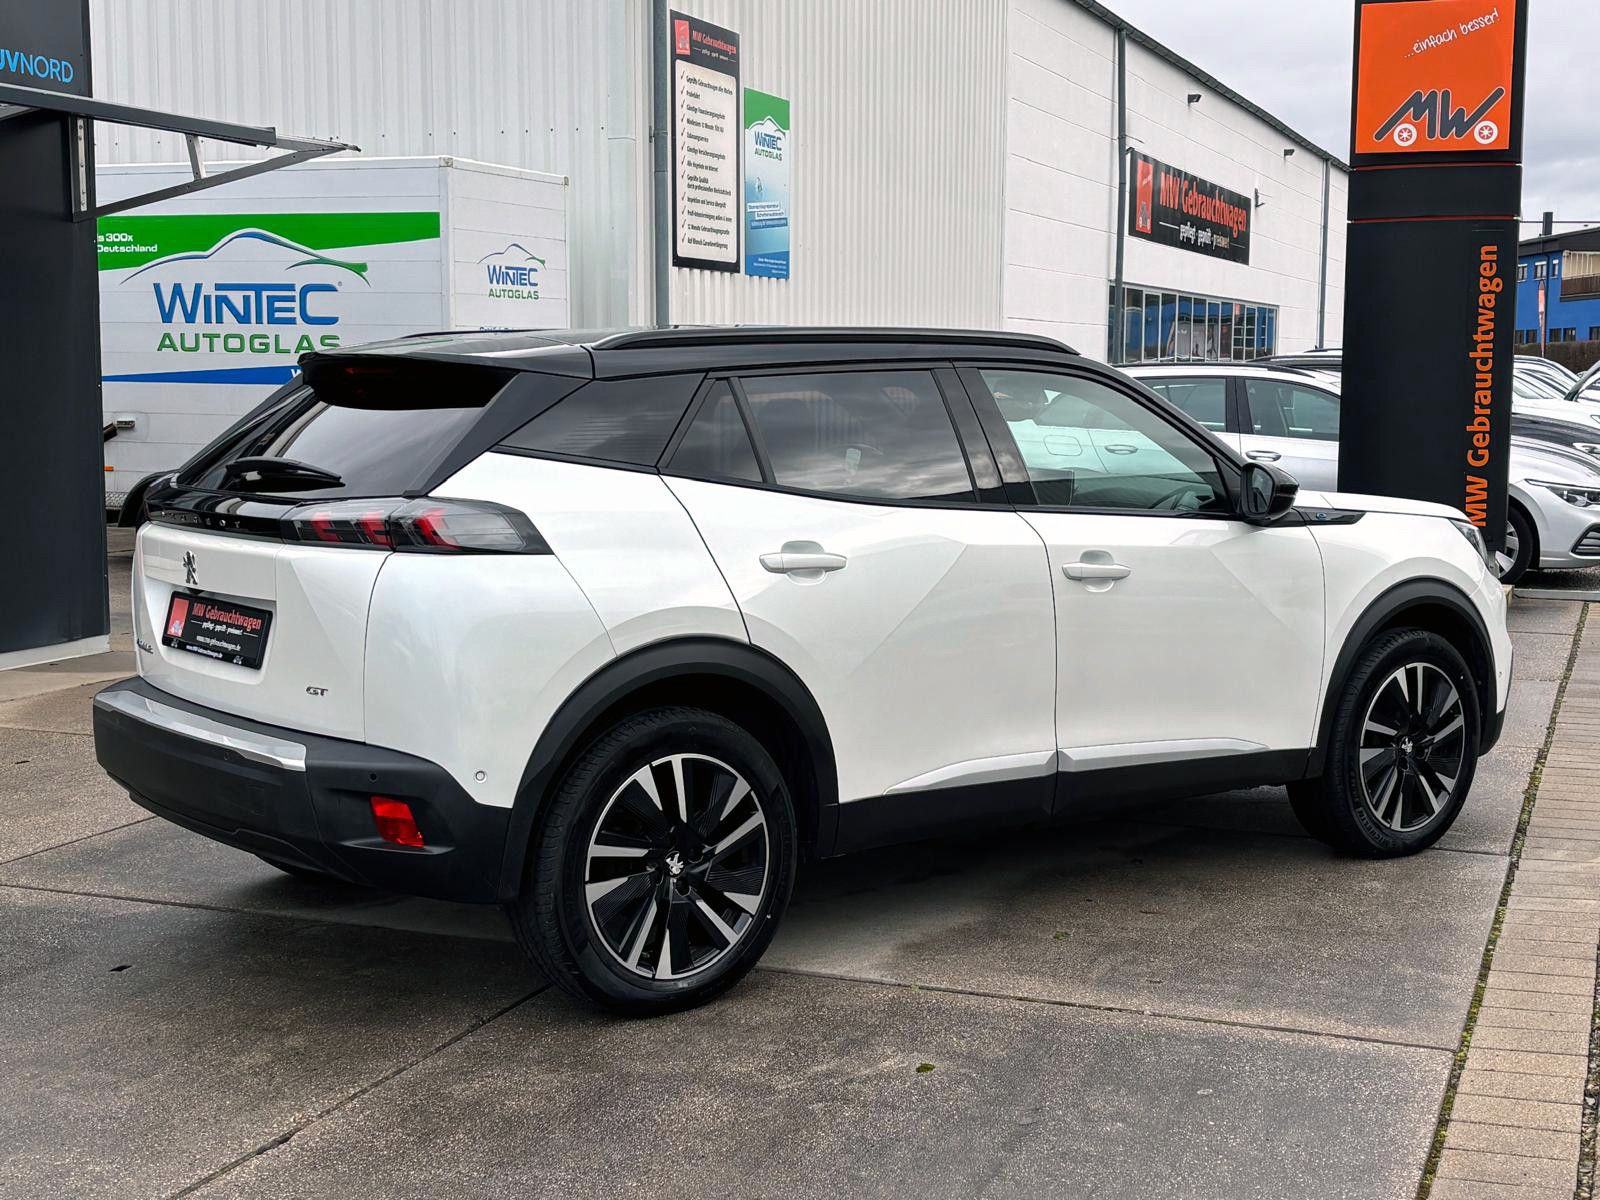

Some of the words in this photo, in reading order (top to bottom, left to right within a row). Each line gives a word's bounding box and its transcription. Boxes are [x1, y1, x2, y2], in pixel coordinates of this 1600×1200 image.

[1459, 7, 1500, 35] besser!
[1373, 86, 1505, 142] MW
[754, 147, 783, 161] AUTOGLAS
[1160, 171, 1180, 210] MW
[1182, 180, 1247, 238] Gebrauchtwagen
[97, 244, 158, 253] Deutschland
[105, 233, 134, 242] 300x
[488, 288, 540, 300] AUTOGLAS
[157, 332, 341, 354] AUTOGLAS
[1466, 245, 1503, 468] Gebrauchtwagen
[1465, 475, 1488, 527] MW
[192, 603, 206, 617] MW
[206, 605, 262, 632] Gebrauchtwagen
[306, 686, 329, 696] GT
